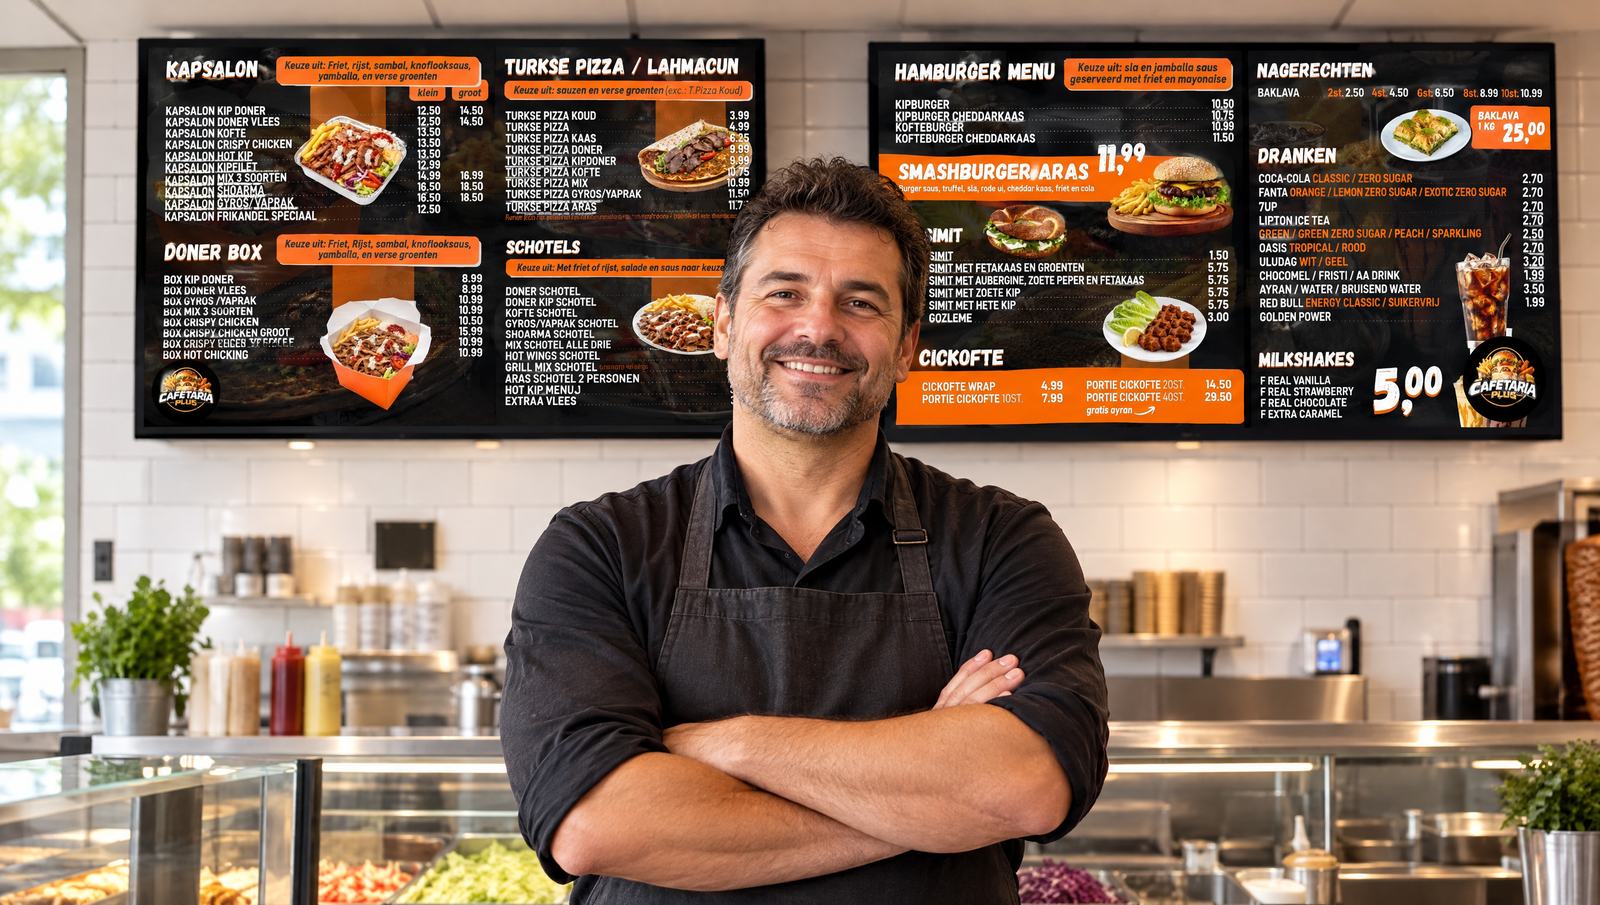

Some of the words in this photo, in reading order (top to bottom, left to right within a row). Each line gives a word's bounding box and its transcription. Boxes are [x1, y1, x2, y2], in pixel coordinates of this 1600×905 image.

[165, 60, 259, 79] KAPSALON
[284, 61, 308, 69] Keuze
[328, 61, 350, 72] Friet,
[352, 61, 371, 73] rijst,
[374, 61, 408, 72] sambal,
[411, 61, 472, 72] knoflooksaus,
[504, 58, 569, 75] TURKSE
[575, 58, 625, 75] PIZZA
[647, 58, 739, 75] LAHMACUN
[1077, 63, 1105, 71] Keuze
[1107, 63, 1123, 72] uit:
[1152, 63, 1194, 73] jamballa
[1257, 63, 1374, 78] NAGERECHTEN
[399, 73, 438, 82] groenten
[894, 63, 1001, 82] HAMBURGER
[1007, 63, 1056, 82] MENU
[1070, 75, 1121, 85] geserveerd
[1123, 75, 1141, 83] met
[1143, 74, 1163, 83] friet
[1177, 75, 1227, 85] mayonaise
[458, 90, 482, 98] groot
[513, 86, 539, 94] Keuze
[541, 86, 555, 94] uit:
[626, 88, 664, 96] groenten
[718, 86, 743, 96] Koud)
[1258, 88, 1300, 97] BAKLAVA
[1345, 88, 1365, 97] 2.50
[895, 100, 950, 110] KIPBURGER
[1211, 99, 1235, 109] 10.50
[165, 106, 215, 116] KAPSALON
[217, 106, 233, 116] KIP
[234, 106, 266, 116] DONER
[417, 106, 441, 116] 12.50
[460, 106, 484, 116] 14.50
[505, 111, 541, 120] TURKSE
[543, 111, 569, 120] PIZZA
[571, 111, 597, 120] KOUD
[729, 111, 750, 120] 3.99
[1477, 111, 1519, 120] BAKLAVA
[1478, 122, 1482, 130] 1
[1483, 122, 1495, 130] KG
[165, 128, 215, 138] KAPSALON
[217, 128, 246, 138] KOFTE
[417, 128, 441, 138] 13.50
[895, 133, 963, 144] KOFTEBURGER
[965, 133, 1036, 144] CHEDDARKAAS
[1213, 132, 1235, 143] 11.50
[1258, 147, 1337, 164] DRANKEN
[898, 163, 1032, 180] SMASHBURGER
[1038, 163, 1089, 180] ARAS
[505, 179, 541, 187] TURKSE
[543, 179, 569, 187] PIZZA
[571, 179, 588, 187] MIX
[727, 179, 750, 187] 10.99
[1259, 202, 1278, 212] 7UP
[1522, 202, 1543, 212] 2.70
[164, 211, 214, 221] KAPSALON
[217, 211, 269, 221] FRIKANDEL
[271, 211, 317, 221] SPECIAAL
[1259, 216, 1293, 226] LIPTON
[1295, 216, 1310, 226] ICE
[1311, 216, 1330, 226] TEA
[1523, 216, 1543, 226] 2.70
[164, 243, 222, 261] DONER
[227, 243, 263, 261] BOX
[505, 240, 581, 254] SCHOTELS
[601, 264, 619, 273] rijst,
[701, 264, 725, 272] keuze
[929, 262, 953, 273] SIMIT
[955, 262, 973, 273] MET
[975, 262, 1022, 273] FETAKAAS
[1024, 262, 1036, 273] EN
[1037, 262, 1085, 273] GROENTEN
[1207, 262, 1229, 273] 5.75
[164, 275, 183, 284] BOX
[184, 275, 200, 284] KIP
[202, 275, 234, 284] DONER
[461, 275, 483, 284] 8.99
[505, 287, 537, 295] DONER
[538, 287, 581, 295] SCHOTEL
[928, 313, 973, 323] GOZLEME
[1207, 313, 1229, 323] 3.00
[1259, 312, 1297, 322] GOLDEN
[1299, 312, 1332, 322] POWER
[162, 350, 181, 360] BOX
[183, 350, 202, 360] HOT
[204, 350, 249, 360] CHICKING
[458, 348, 483, 358] 10.99
[505, 351, 524, 360] HOT
[526, 351, 557, 360] WINGS
[559, 351, 600, 360] SCHOTEL
[919, 349, 1004, 366] CICKOFTE
[1258, 351, 1355, 368] MILKSHAKES
[922, 380, 967, 391] CICKOFTE
[969, 380, 996, 391] WRAP
[1040, 380, 1064, 391] 4.99
[1086, 380, 1118, 390] PORTIE
[1119, 380, 1161, 390] CICKOFTE
[1205, 380, 1232, 390] 14.50
[1260, 376, 1266, 386] F
[1268, 376, 1291, 386] REAL
[1292, 376, 1331, 386] VANILLA
[1468, 380, 1536, 399] CAFETARIA
[158, 391, 214, 403] CAFETARIA
[1491, 391, 1517, 400] PLUS
[505, 397, 544, 406] EXTRAA
[546, 397, 577, 406] VLEES
[1086, 407, 1109, 416] gratis
